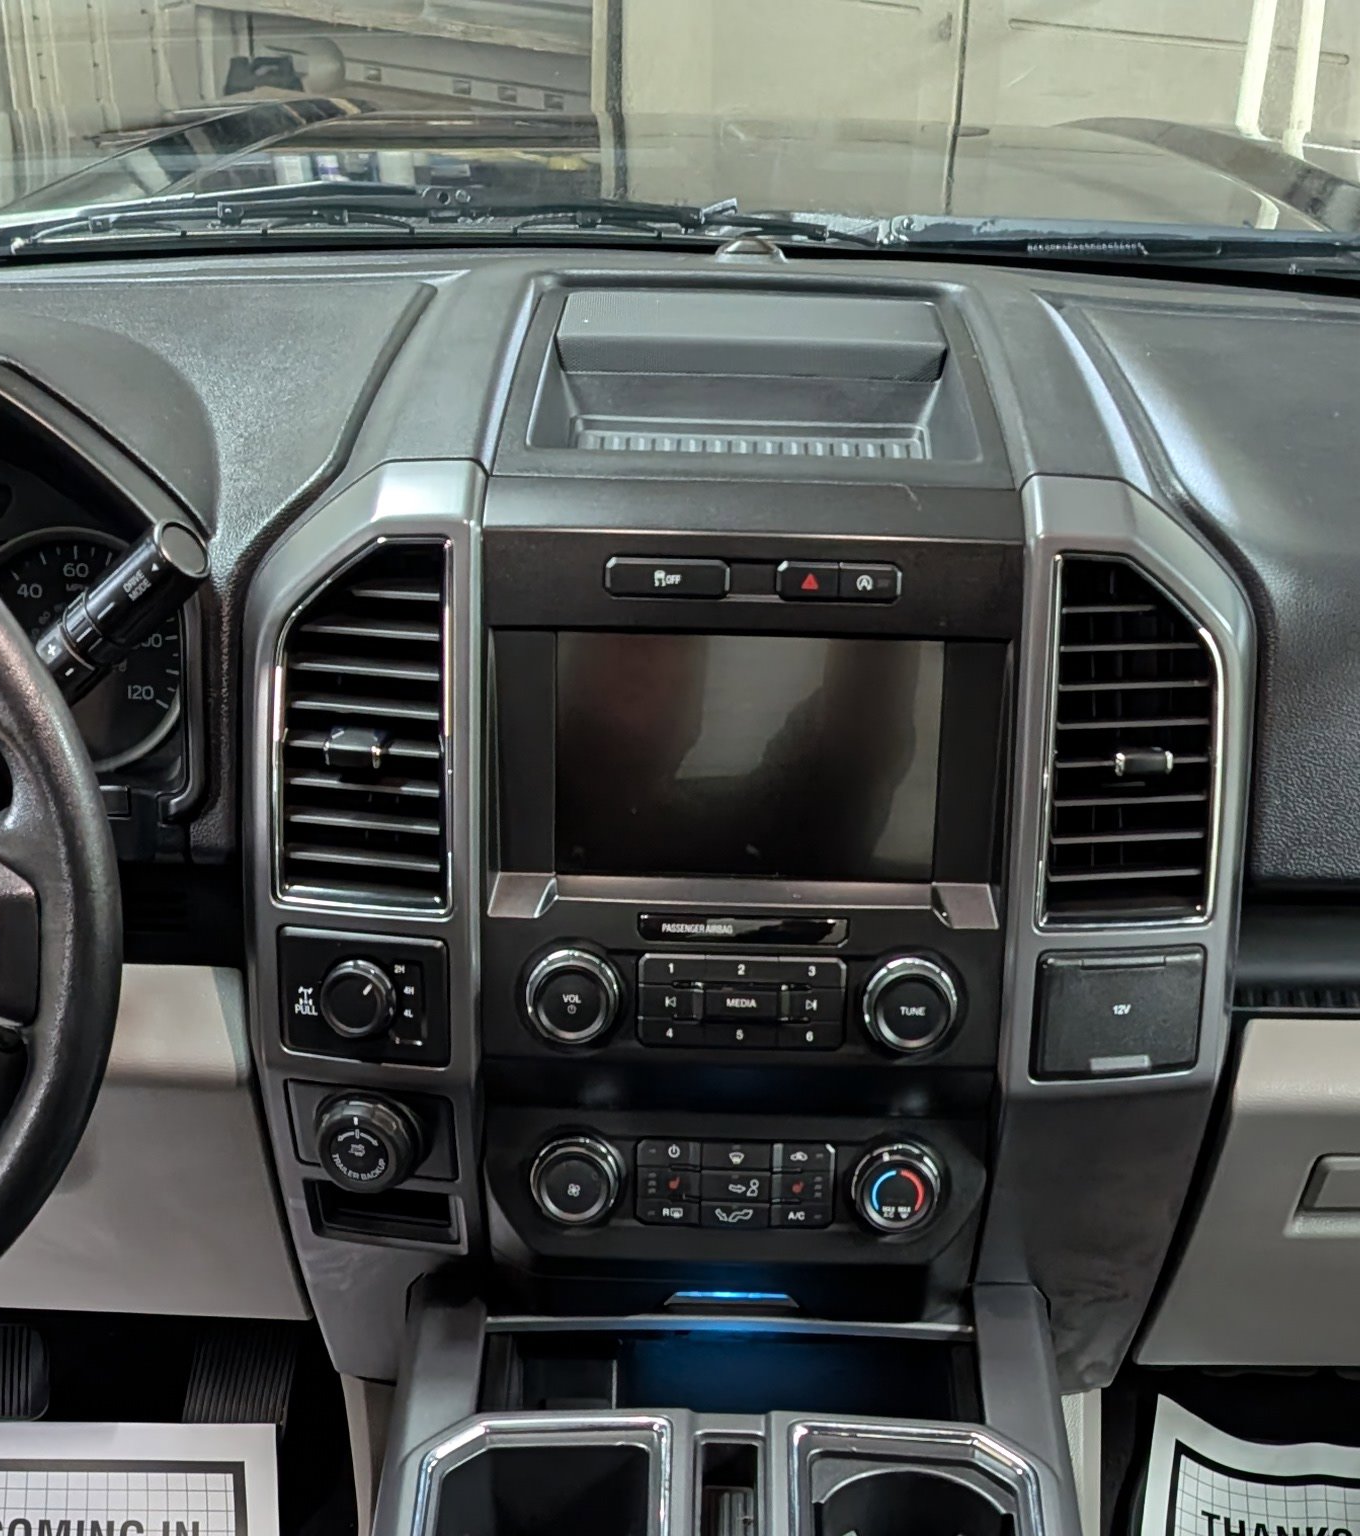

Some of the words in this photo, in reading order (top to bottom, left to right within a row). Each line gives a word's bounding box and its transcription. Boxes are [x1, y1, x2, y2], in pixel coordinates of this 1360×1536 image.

[63, 562, 89, 579] 60
[122, 568, 146, 593] DRIVE
[666, 574, 682, 586] OFF
[17, 584, 43, 600] 40
[128, 577, 152, 602] MODE
[127, 685, 154, 701] 120
[661, 923, 707, 934] PASSENGER
[706, 924, 733, 935] AIRBAG
[668, 963, 674, 974] 1
[737, 964, 746, 975] 2
[808, 966, 816, 977] 3
[562, 994, 582, 1004] VOL
[726, 998, 757, 1008] MEDIA
[294, 1003, 318, 1016] PULL
[900, 1006, 926, 1016] TUNE
[1112, 1004, 1131, 1016] 12V
[666, 1028, 673, 1039] 4
[736, 1029, 744, 1040] 5
[806, 1031, 814, 1042] 6
[332, 1153, 360, 1179] TRAILER
[360, 1158, 386, 1181] BACKUP
[787, 1212, 806, 1221] A/C
